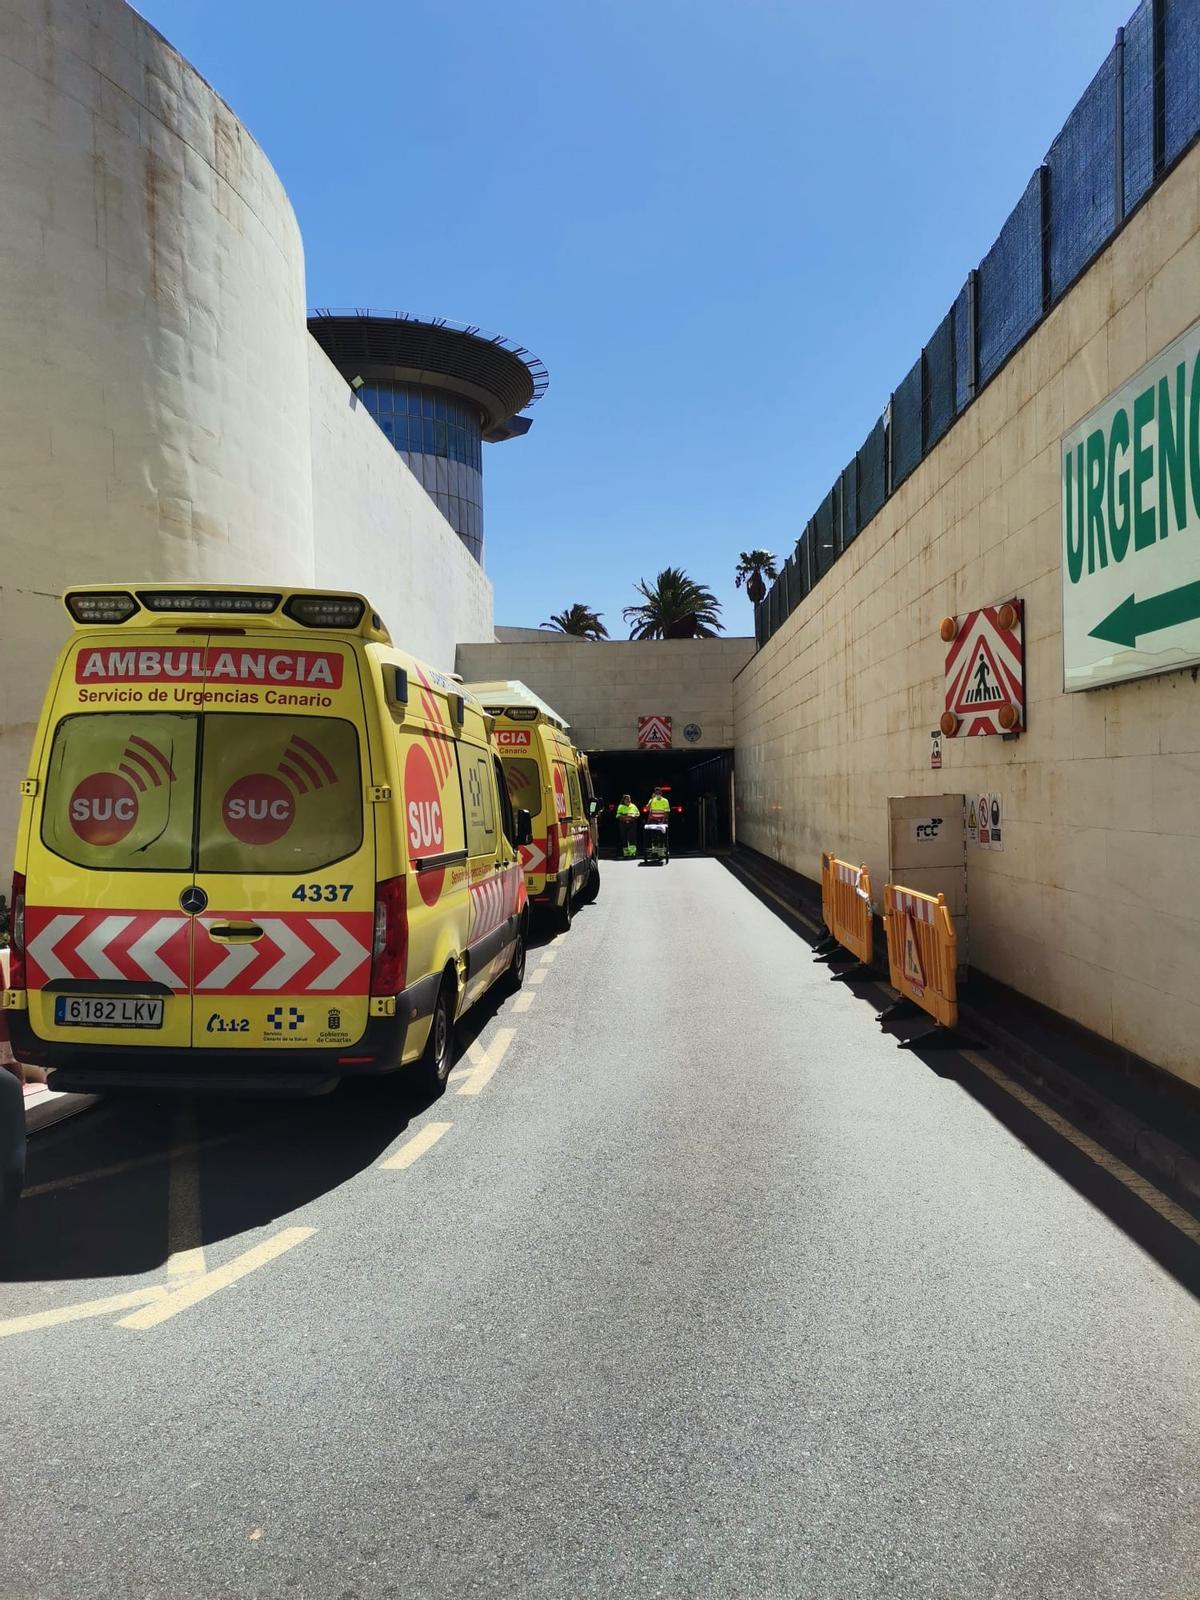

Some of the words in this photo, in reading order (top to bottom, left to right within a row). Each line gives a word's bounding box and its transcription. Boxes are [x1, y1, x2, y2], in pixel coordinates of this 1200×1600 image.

[82, 652, 334, 683] AMBULANCIA
[78, 688, 142, 702] Servicio
[149, 689, 168, 702] de
[173, 689, 259, 705] Urgencias
[265, 690, 332, 707] Canario
[72, 798, 135, 821] SUC
[228, 799, 289, 820] SUC
[408, 801, 442, 849] SUC
[291, 884, 354, 902] 4337
[70, 1001, 116, 1020] 6182
[122, 1002, 158, 1021] LKV
